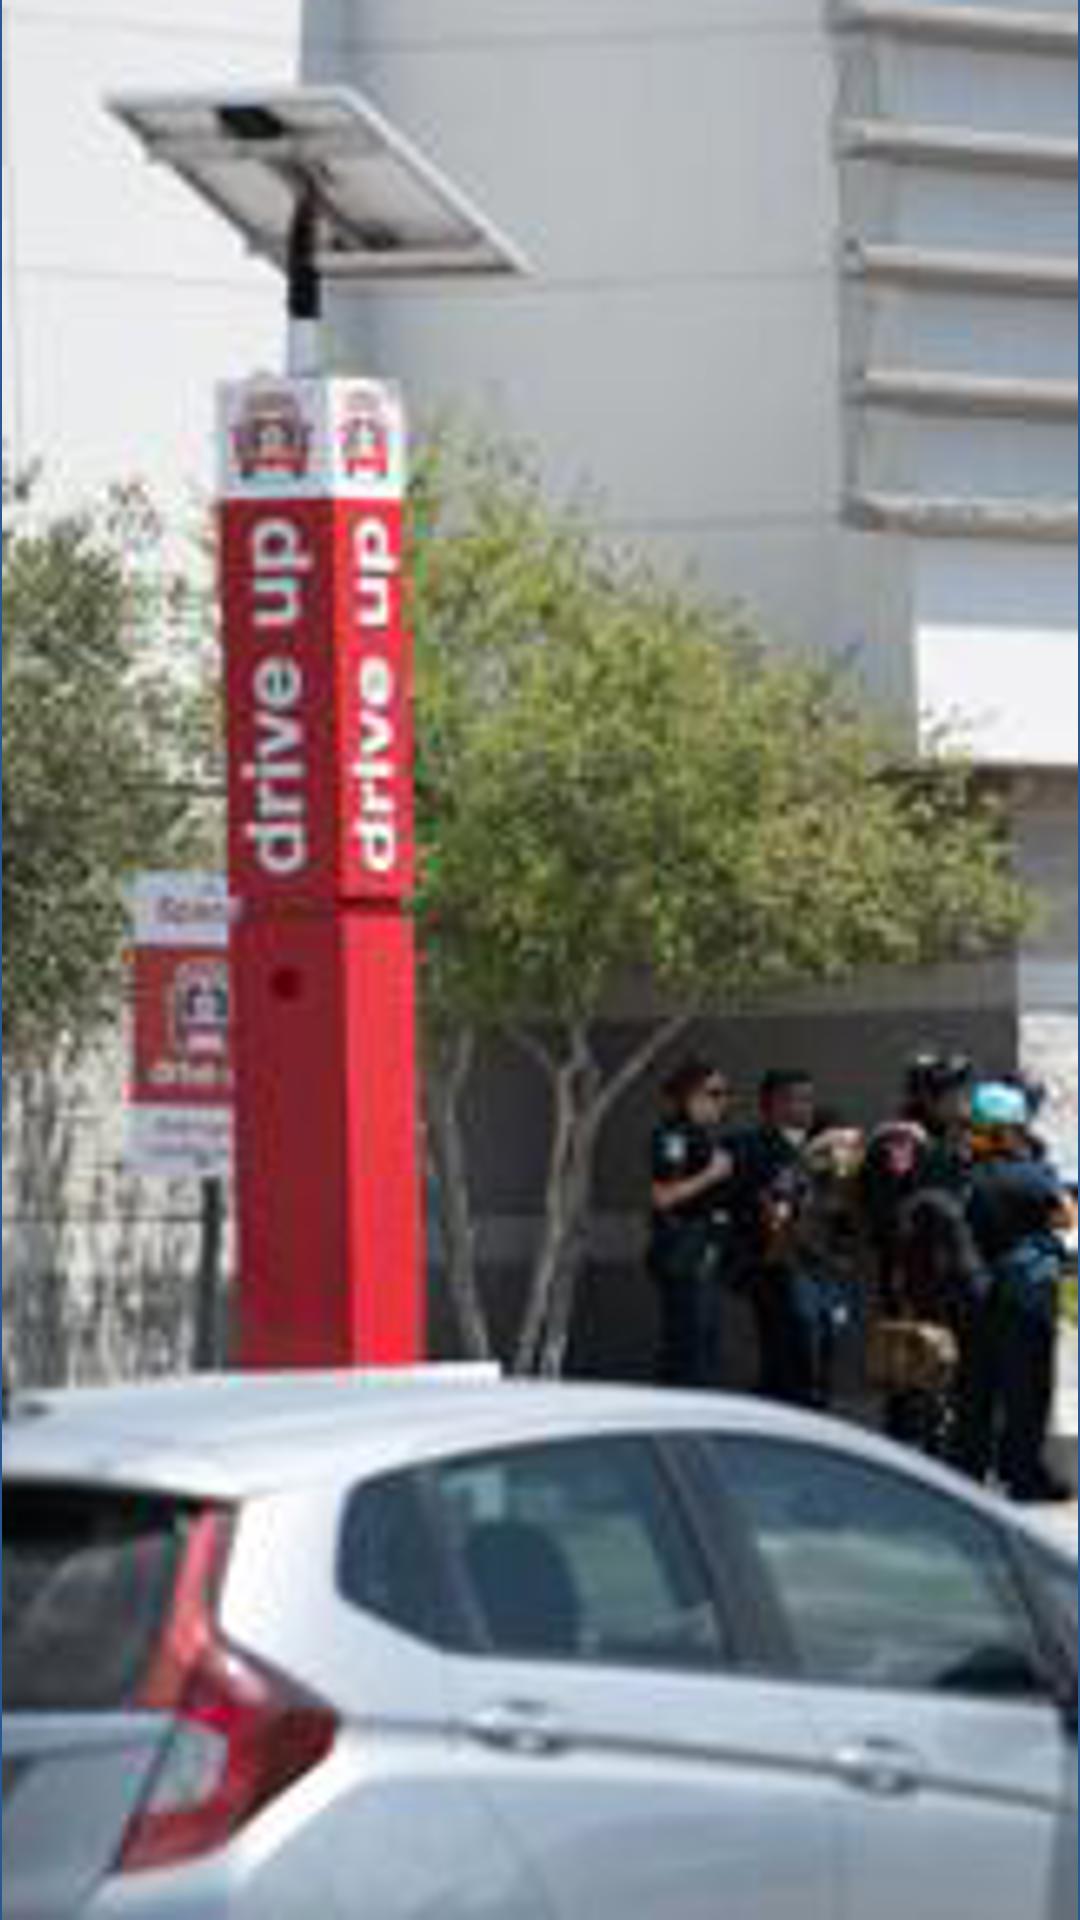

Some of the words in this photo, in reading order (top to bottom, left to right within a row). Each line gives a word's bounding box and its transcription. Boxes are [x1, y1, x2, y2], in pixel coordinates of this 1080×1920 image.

[253, 518, 311, 626] up
[354, 518, 398, 626] up
[242, 657, 304, 872] drive
[348, 658, 397, 871] drive
